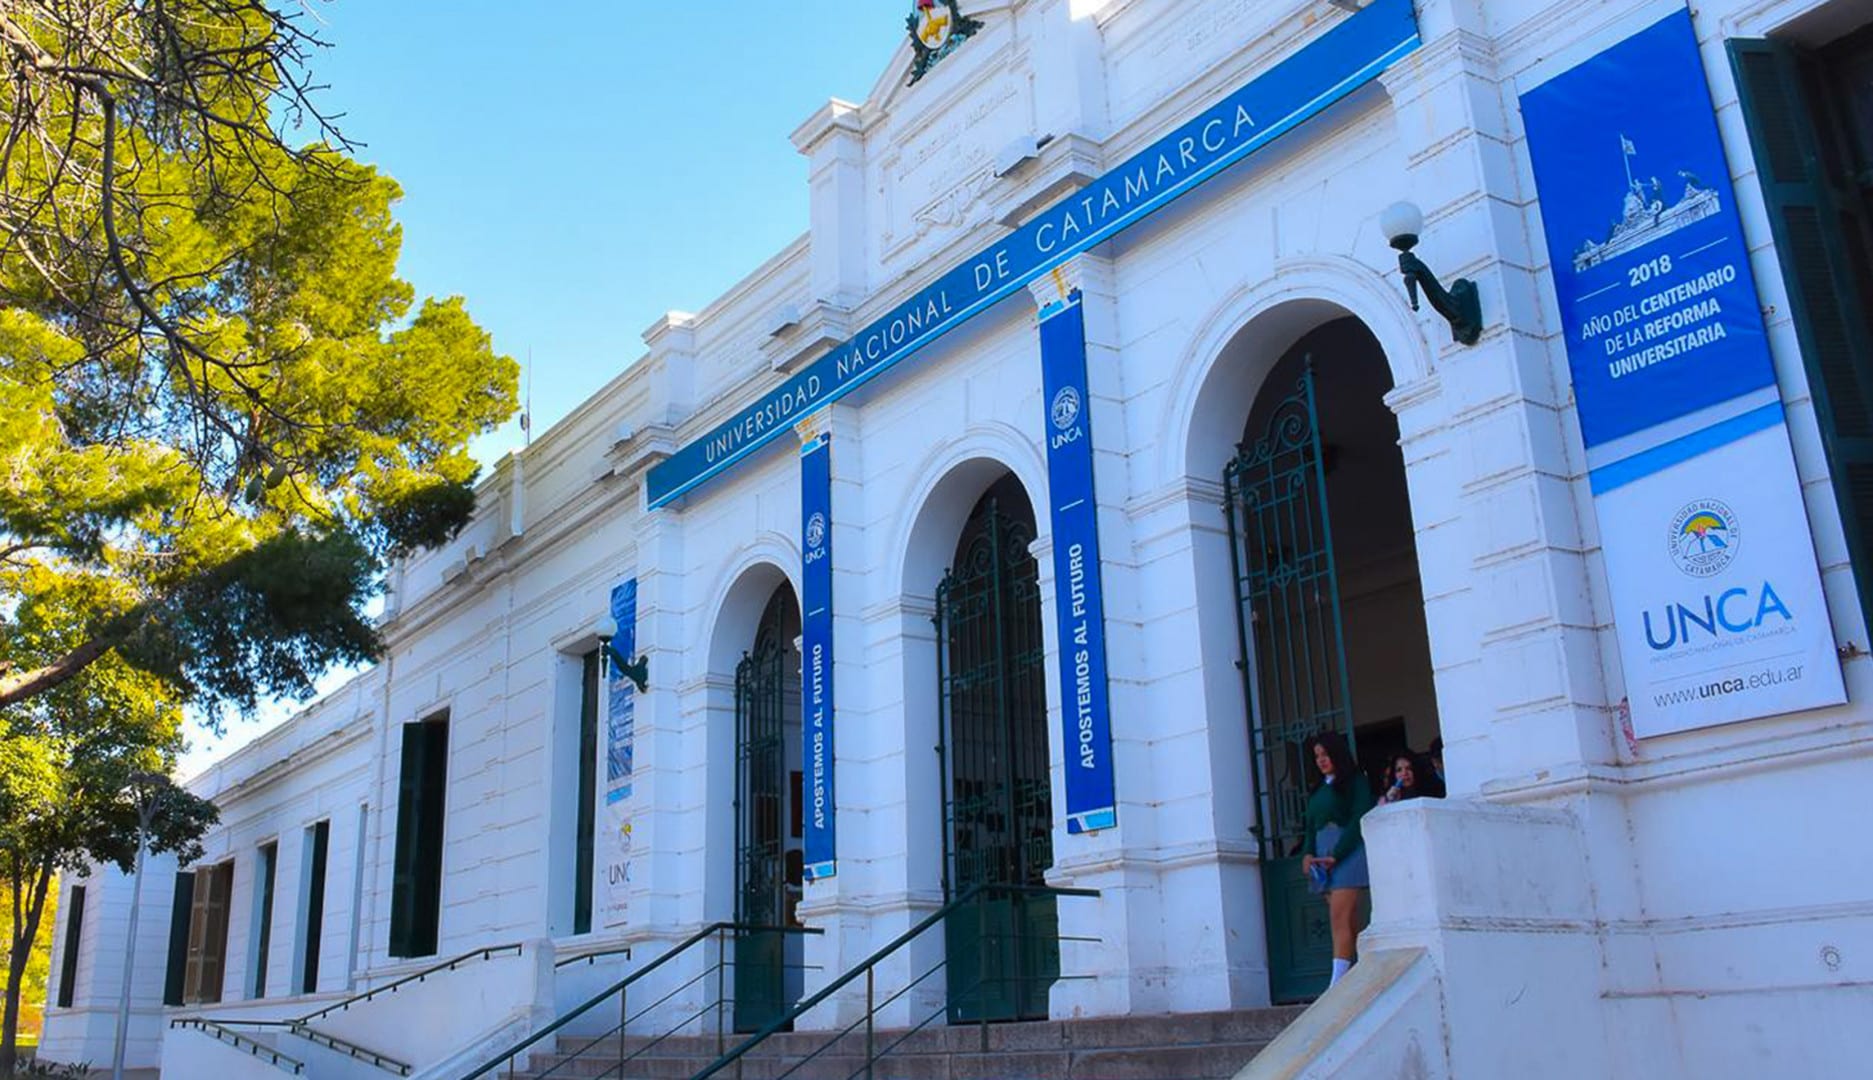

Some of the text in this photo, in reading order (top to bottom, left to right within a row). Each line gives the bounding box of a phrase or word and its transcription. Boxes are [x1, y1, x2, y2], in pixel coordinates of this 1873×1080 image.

[705, 375, 821, 463] UNIVERSIDAD
[836, 290, 953, 380] NACIONAL
[973, 249, 1010, 292] DE
[1035, 104, 1255, 253] CATAMARCA
[1582, 264, 1736, 340] AÑO DEL CENTENARIO
[1628, 254, 1672, 287] 2018
[1605, 297, 1722, 355] DE LA REFORMA
[1609, 322, 1727, 379] UNIVERSITARIA
[1052, 426, 1083, 449] UNCA
[1642, 580, 1793, 651] UNCA
[1069, 543, 1095, 769] APOSTEMOS AL FUTURO
[1653, 664, 1804, 707] www.unca.edu.ar
[812, 643, 825, 829] APOSTEMOS AL FUTURO
